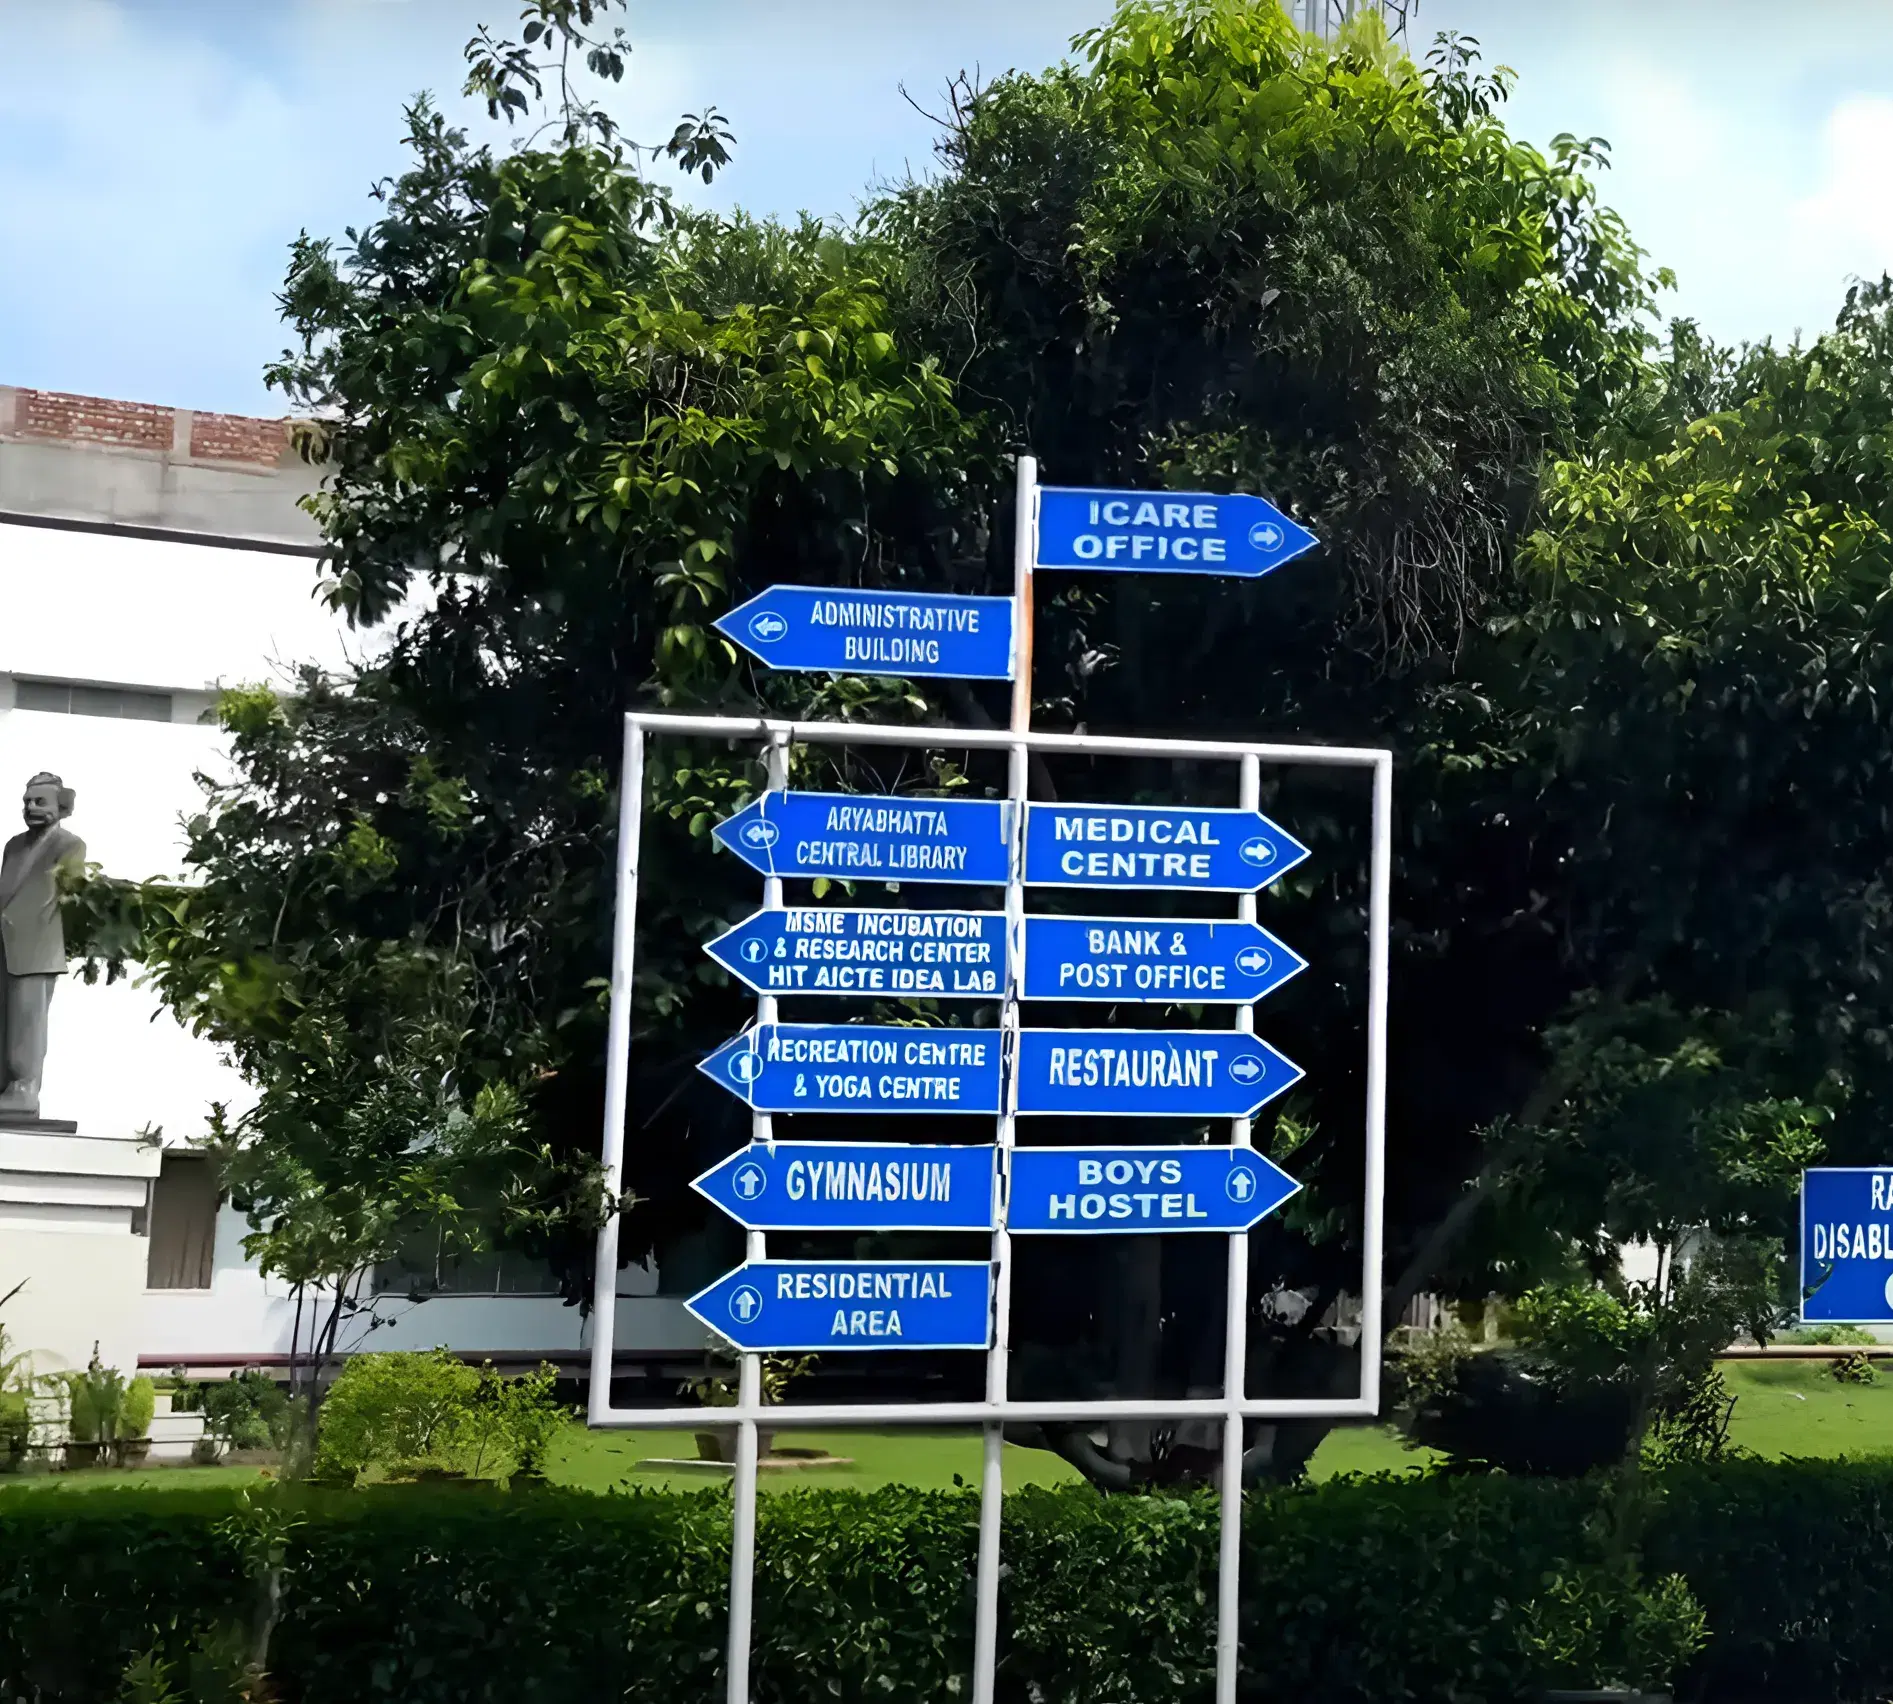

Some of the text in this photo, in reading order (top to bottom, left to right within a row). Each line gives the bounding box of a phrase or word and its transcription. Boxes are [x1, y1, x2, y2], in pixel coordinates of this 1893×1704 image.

[1089, 501, 1218, 529] ICARE
[1073, 535, 1227, 562] OFFICE
[810, 601, 980, 633] ADMINISTRATIVE
[844, 637, 940, 663] BUILDING
[826, 806, 948, 836] ARYABHATTA
[1055, 817, 1221, 846] MEDICAL
[796, 843, 968, 871] CENTRAL LIBRARY
[1062, 851, 1211, 879] CENTRE
[786, 912, 982, 938] MSME INCUBATION
[774, 937, 991, 963] & RESEARCH CENTER
[1087, 930, 1187, 955] BANK &
[769, 965, 996, 991] HIT AICTE IDEA LAB
[1060, 963, 1226, 990] POST OFFICE
[768, 1038, 986, 1066] RECREATION CENTRE
[1050, 1046, 1218, 1088] RESTAURANT
[794, 1073, 960, 1100] & YOGA CENTRE
[786, 1161, 951, 1202] GYMNASIUM
[1079, 1159, 1182, 1186] BOYS
[1049, 1192, 1208, 1220] HOSTEL
[777, 1272, 952, 1299] RESIDENTIAL
[831, 1309, 902, 1336] AREA
